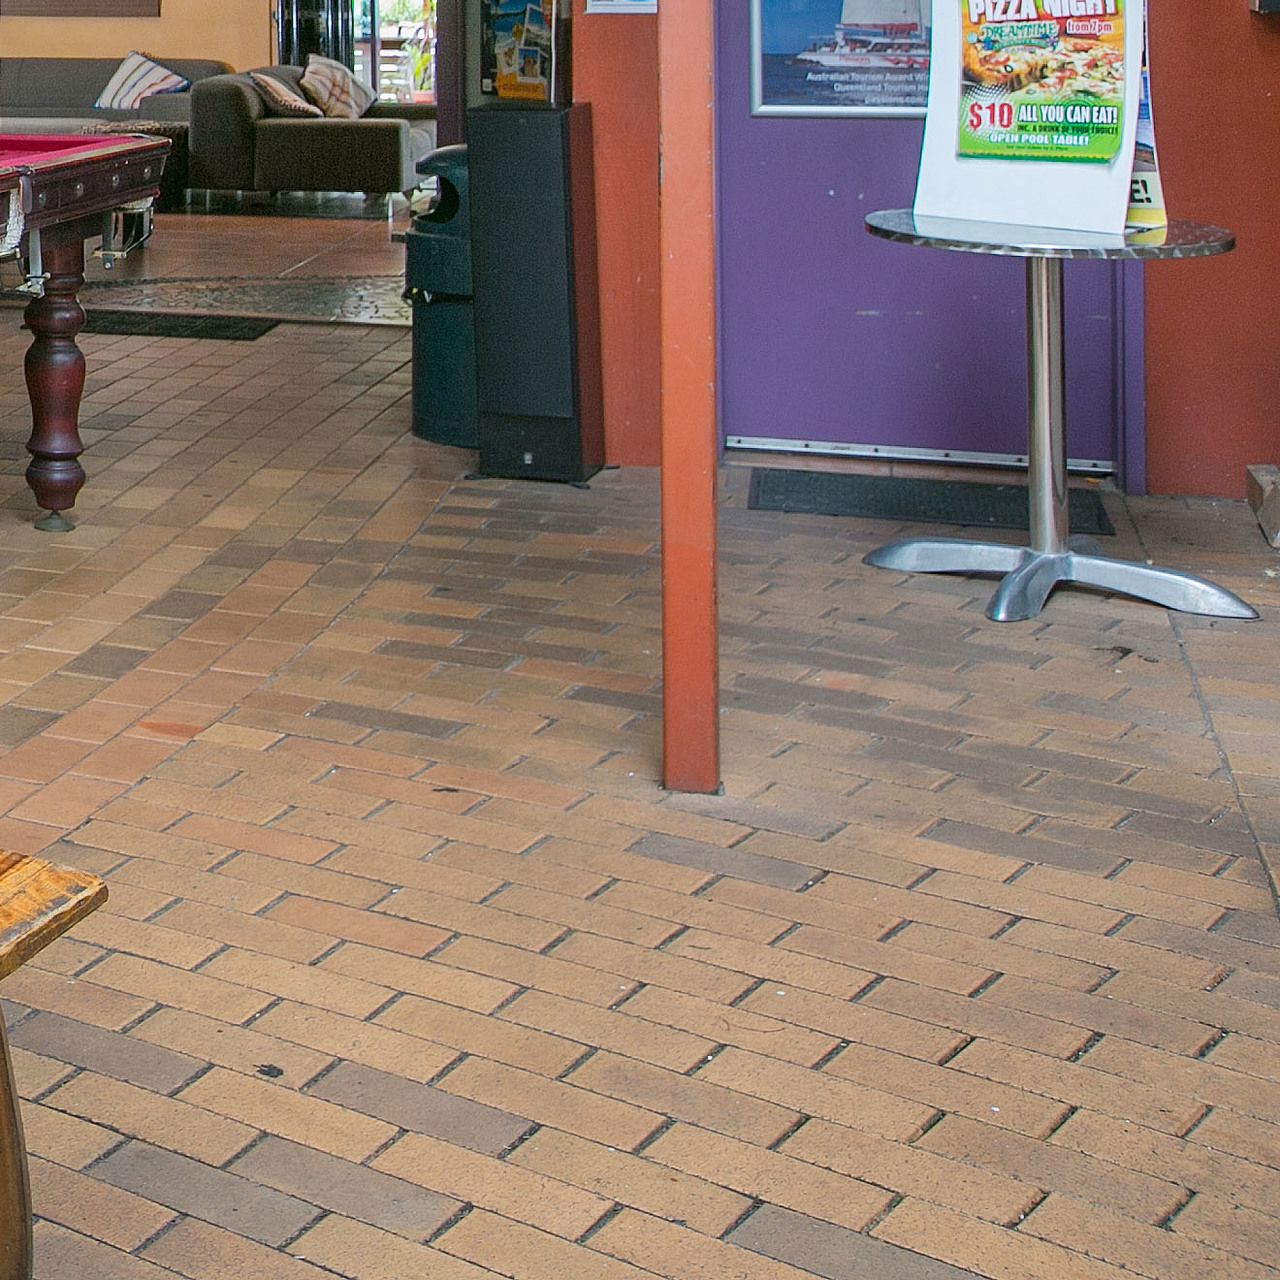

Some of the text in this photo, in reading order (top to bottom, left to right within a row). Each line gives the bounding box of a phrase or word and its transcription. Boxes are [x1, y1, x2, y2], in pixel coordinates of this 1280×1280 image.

[983, 23, 1058, 39] DREAMTIME
[1067, 21, 1112, 35] from 7pm
[968, 102, 1118, 131] $10 ALL YOU CAN EAT!
[989, 133, 1089, 146] OPEN POOL TABLE!
